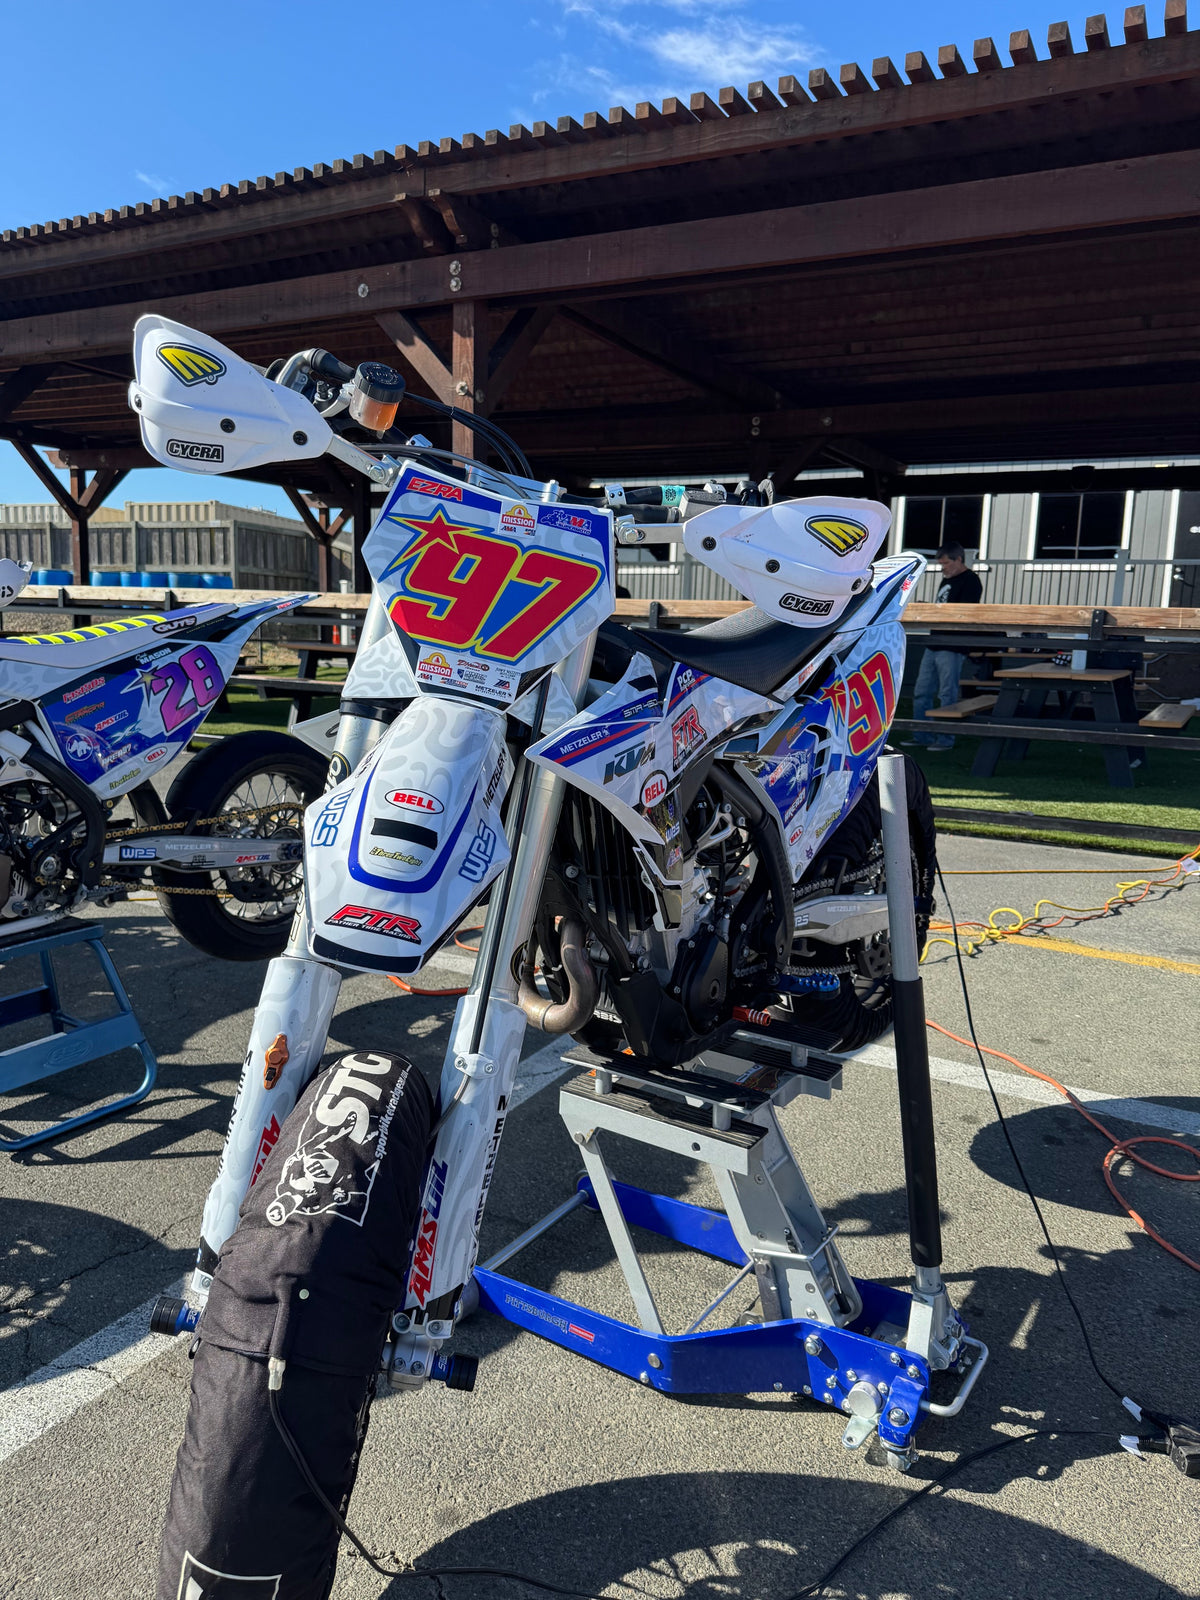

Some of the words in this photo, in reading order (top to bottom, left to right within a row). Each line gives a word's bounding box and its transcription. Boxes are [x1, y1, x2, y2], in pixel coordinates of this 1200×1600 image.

[168, 441, 222, 460] CYCRA
[406, 477, 463, 501] EZRA
[502, 515, 534, 527] MISSION
[389, 528, 602, 662] 97
[782, 595, 832, 613] CYCRA
[153, 616, 197, 633] GUTS
[140, 648, 172, 664] MASON
[419, 662, 451, 676] MISSION
[676, 669, 693, 691] PCP
[152, 645, 225, 733] 28
[475, 685, 507, 695] METZELER
[838, 651, 895, 756] 97
[95, 710, 129, 732] AMSOIL
[560, 730, 603, 755] METZELER
[671, 705, 707, 761] FTR
[146, 749, 165, 762] BELL
[603, 741, 656, 785] KTM
[482, 751, 506, 810] METZELER
[644, 778, 666, 804] BELL
[393, 792, 436, 812] BELL
[310, 787, 355, 847] WPS
[165, 843, 212, 851] METZELER
[790, 829, 802, 843] BELL
[121, 847, 156, 859] WPS
[235, 854, 271, 863] AMSOIL
[459, 818, 497, 883] WPS
[327, 919, 361, 928] FATHER
[331, 904, 420, 940] FTR
[793, 913, 810, 928] PS
[316, 1053, 392, 1146] STG
[408, 1157, 449, 1309] AMSOIL
[504, 1293, 568, 1331] PITTSBURGH
